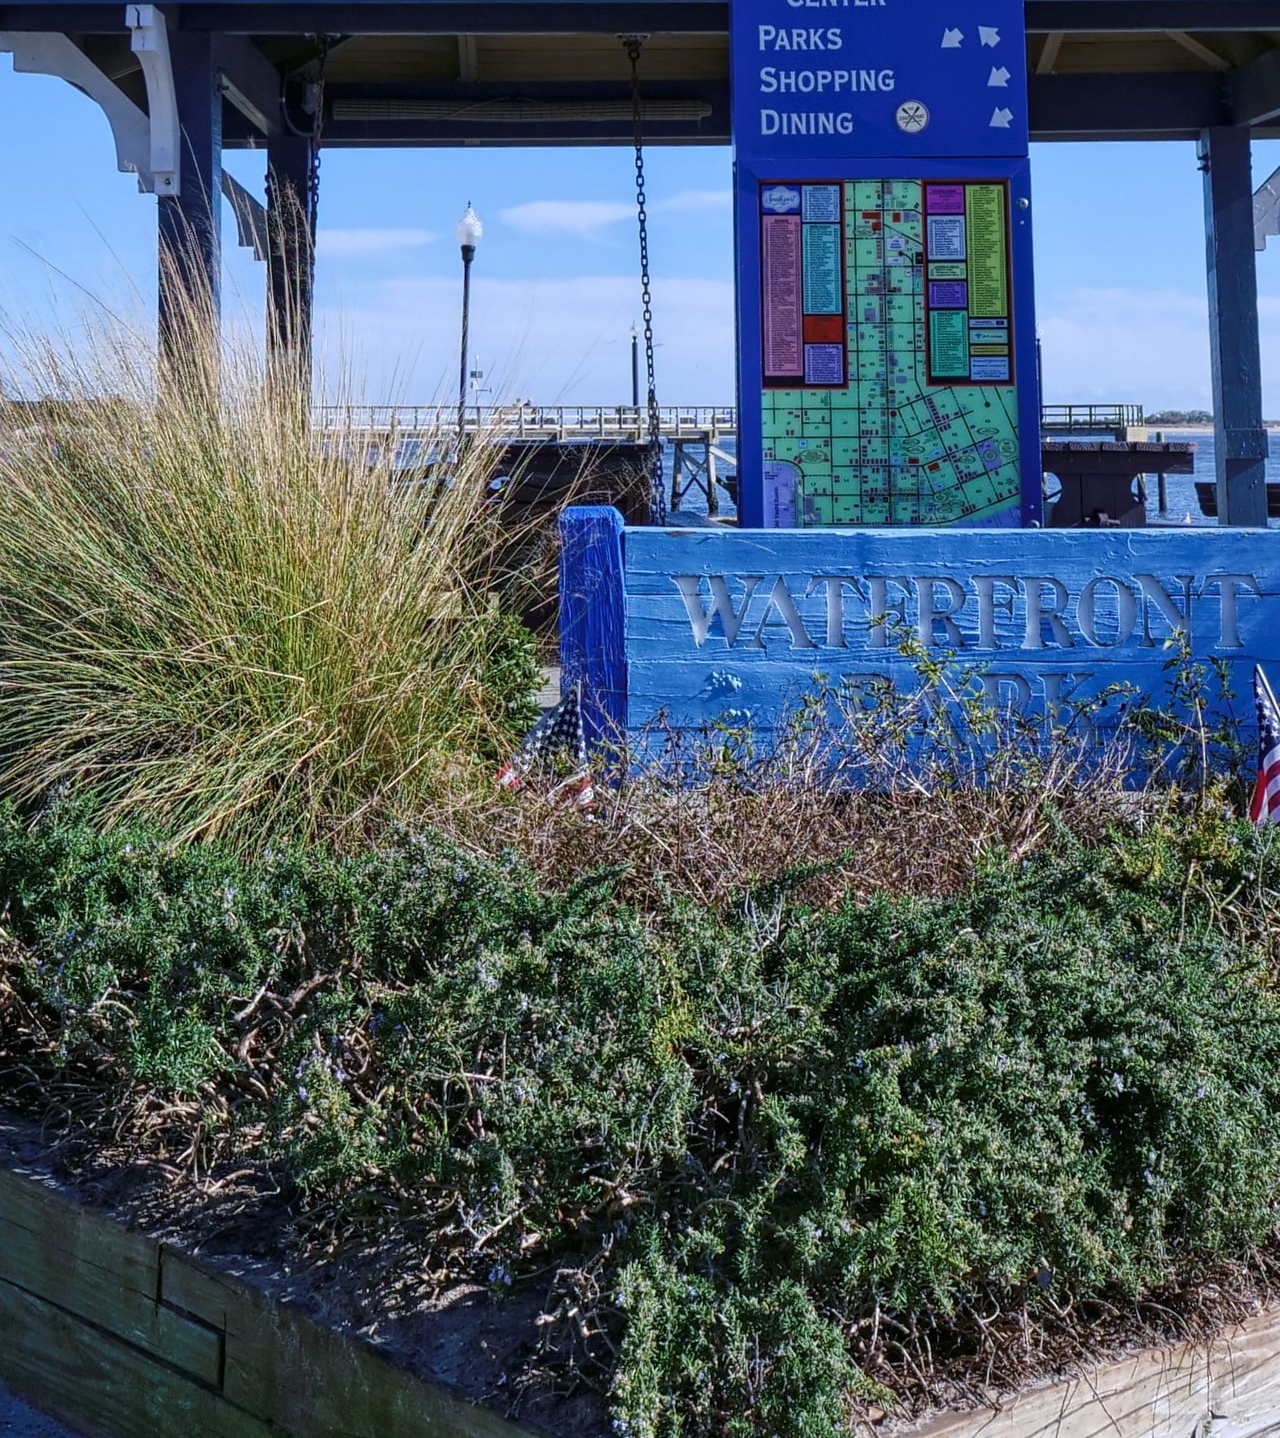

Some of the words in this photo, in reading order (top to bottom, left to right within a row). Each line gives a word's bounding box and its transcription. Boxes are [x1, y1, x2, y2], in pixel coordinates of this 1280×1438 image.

[758, 25, 842, 51] PARKS
[760, 67, 895, 93] SHOPPING
[761, 109, 853, 135] DINING
[669, 572, 1263, 649] WATERFRONT
